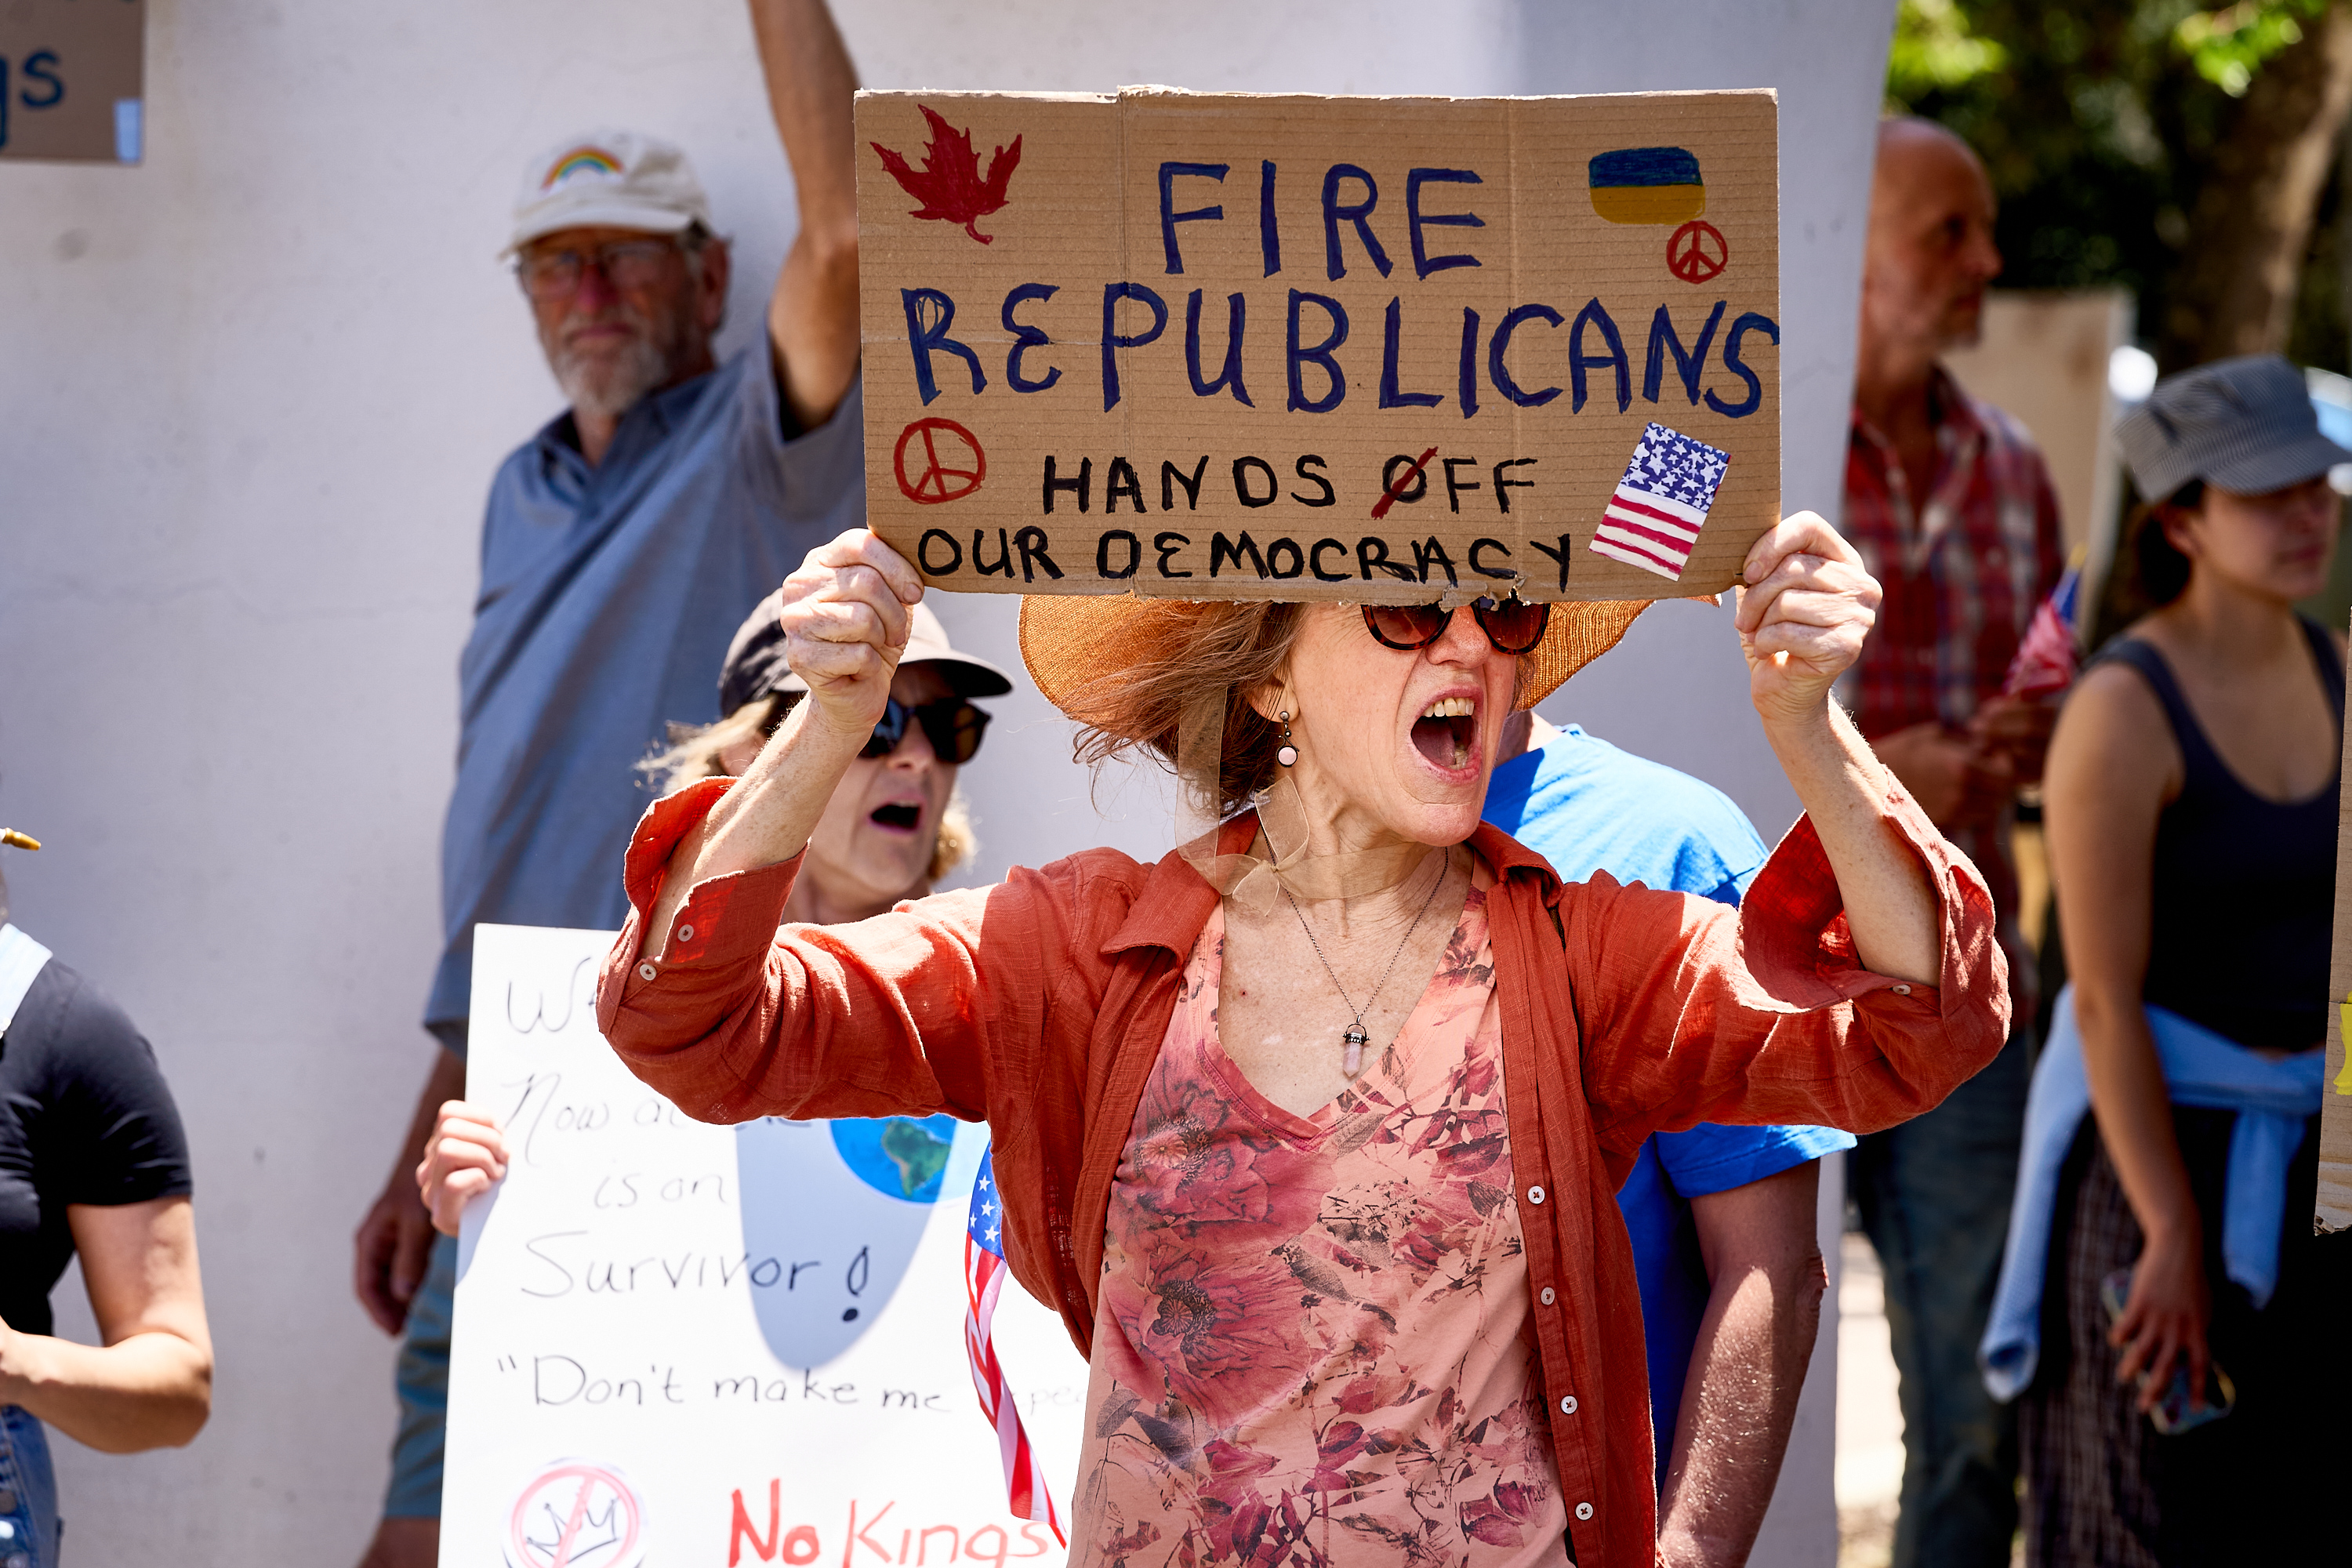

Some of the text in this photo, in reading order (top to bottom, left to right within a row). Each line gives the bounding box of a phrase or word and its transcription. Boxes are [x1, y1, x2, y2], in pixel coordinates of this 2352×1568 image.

[1158, 158, 1485, 281] FIRE
[901, 281, 1780, 419] REPUBLICANS
[1043, 447, 1537, 519] HANDS OFF
[917, 528, 1571, 595] OUR DEMOCRACY
[500, 1073, 611, 1168] Now
[593, 1157, 644, 1210] is
[713, 1367, 861, 1404] make
[880, 1388, 953, 1413] me
[728, 1477, 1051, 1568] No Kings
